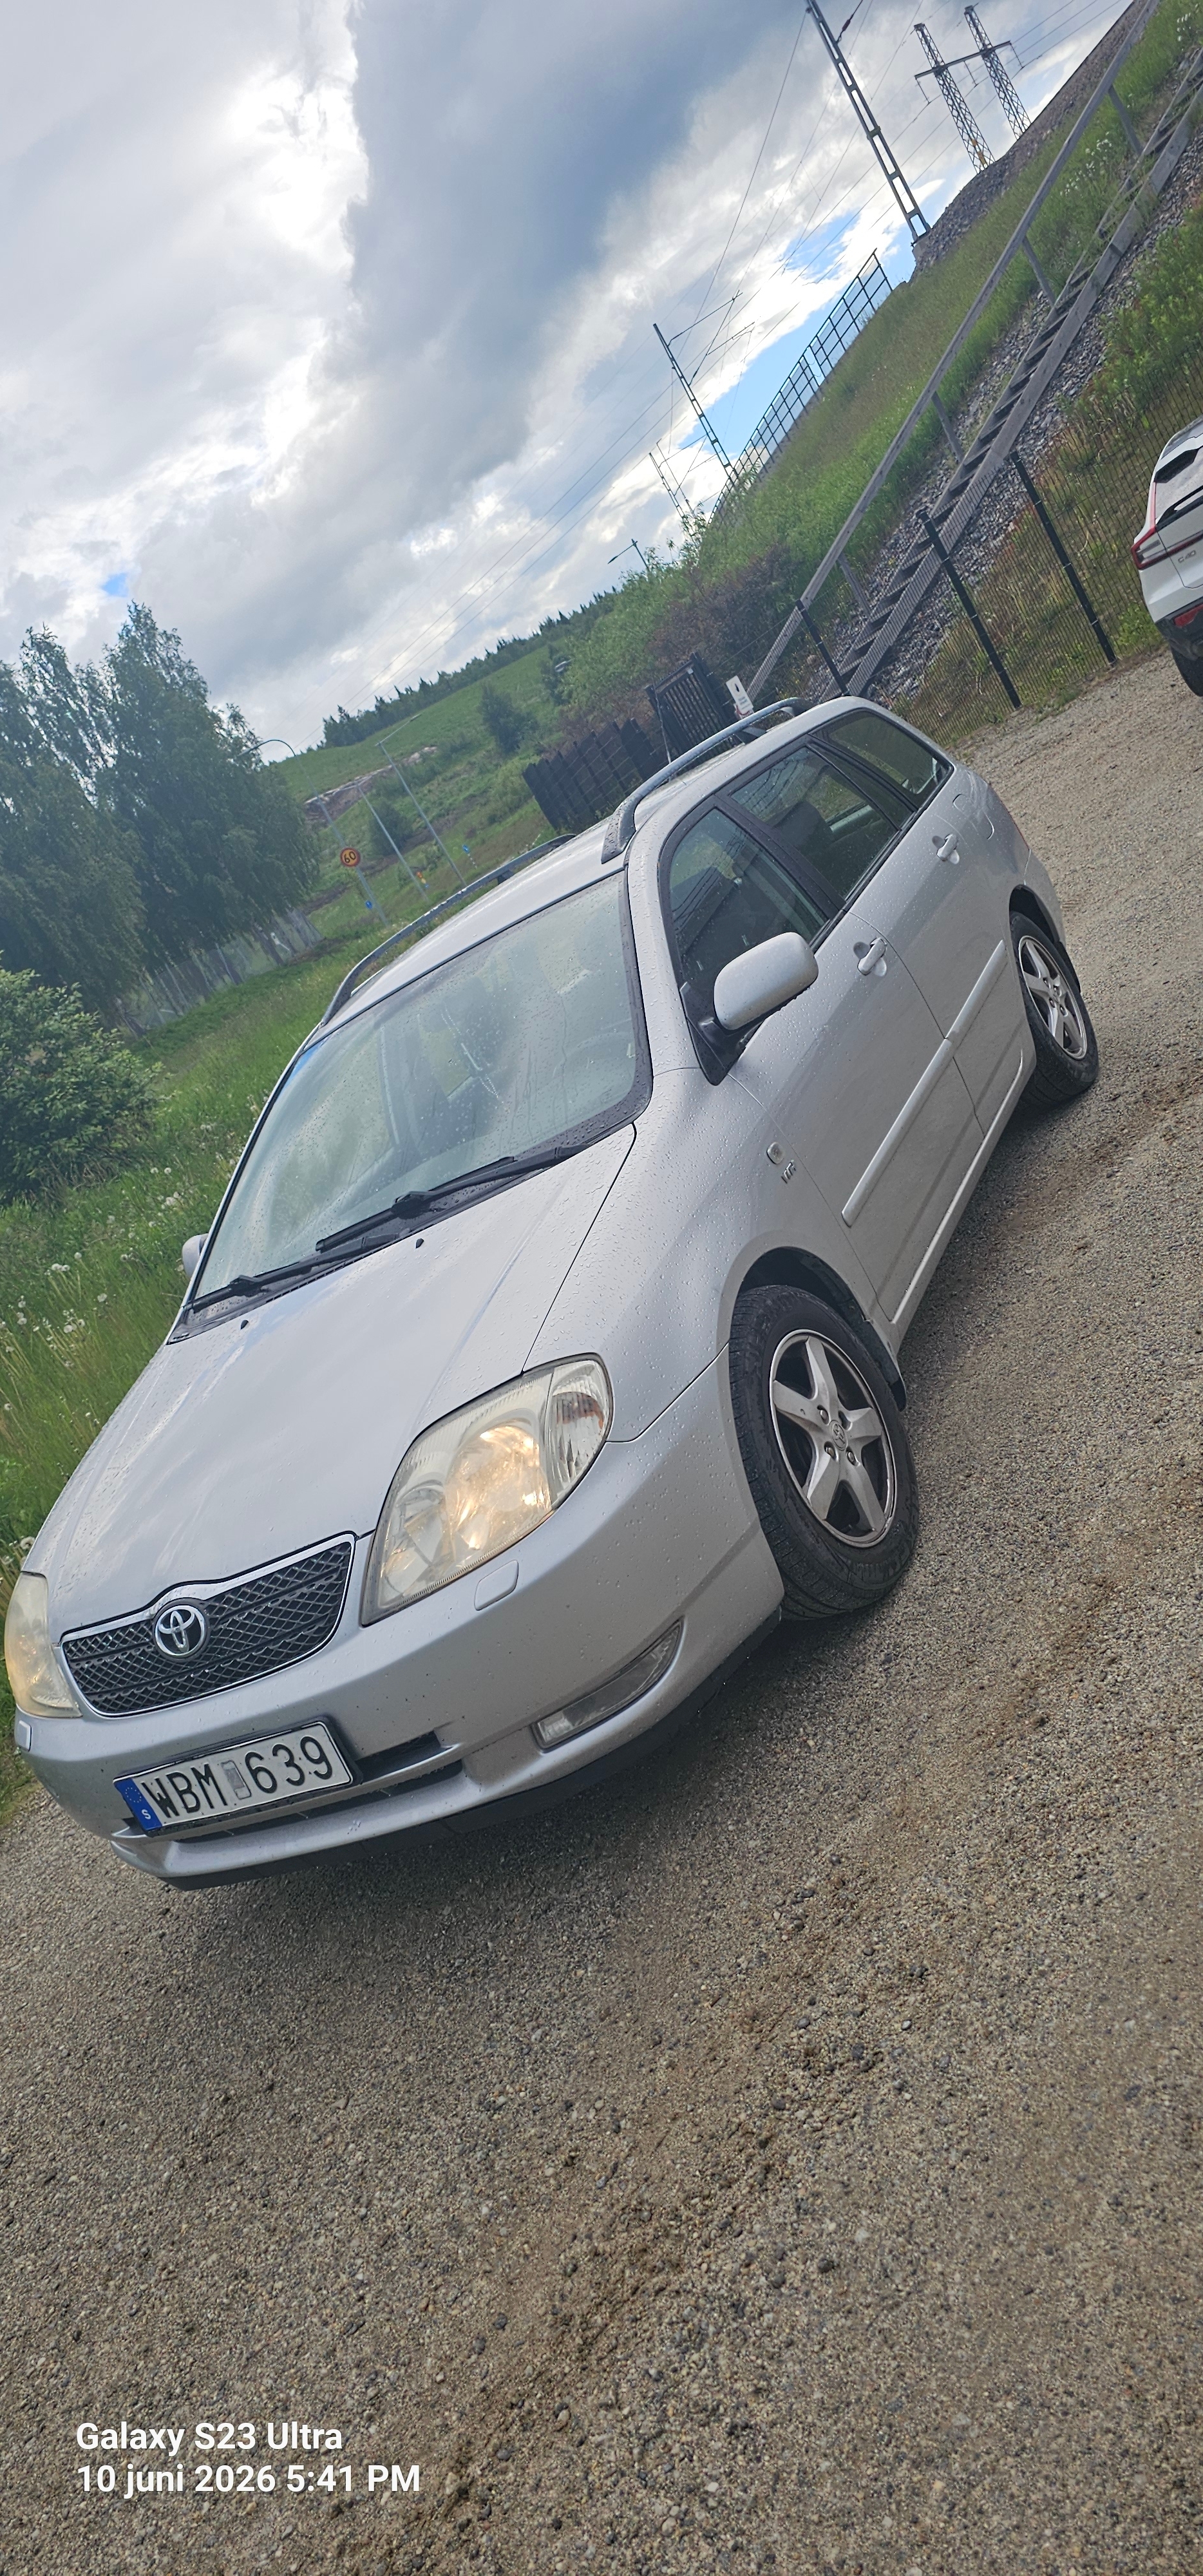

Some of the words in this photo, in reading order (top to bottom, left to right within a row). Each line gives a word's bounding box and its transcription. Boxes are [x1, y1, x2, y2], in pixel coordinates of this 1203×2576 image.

[344, 851, 357, 863] 60
[140, 1763, 229, 1819] WBM
[245, 1735, 334, 1794] 639
[141, 1808, 152, 1820] S
